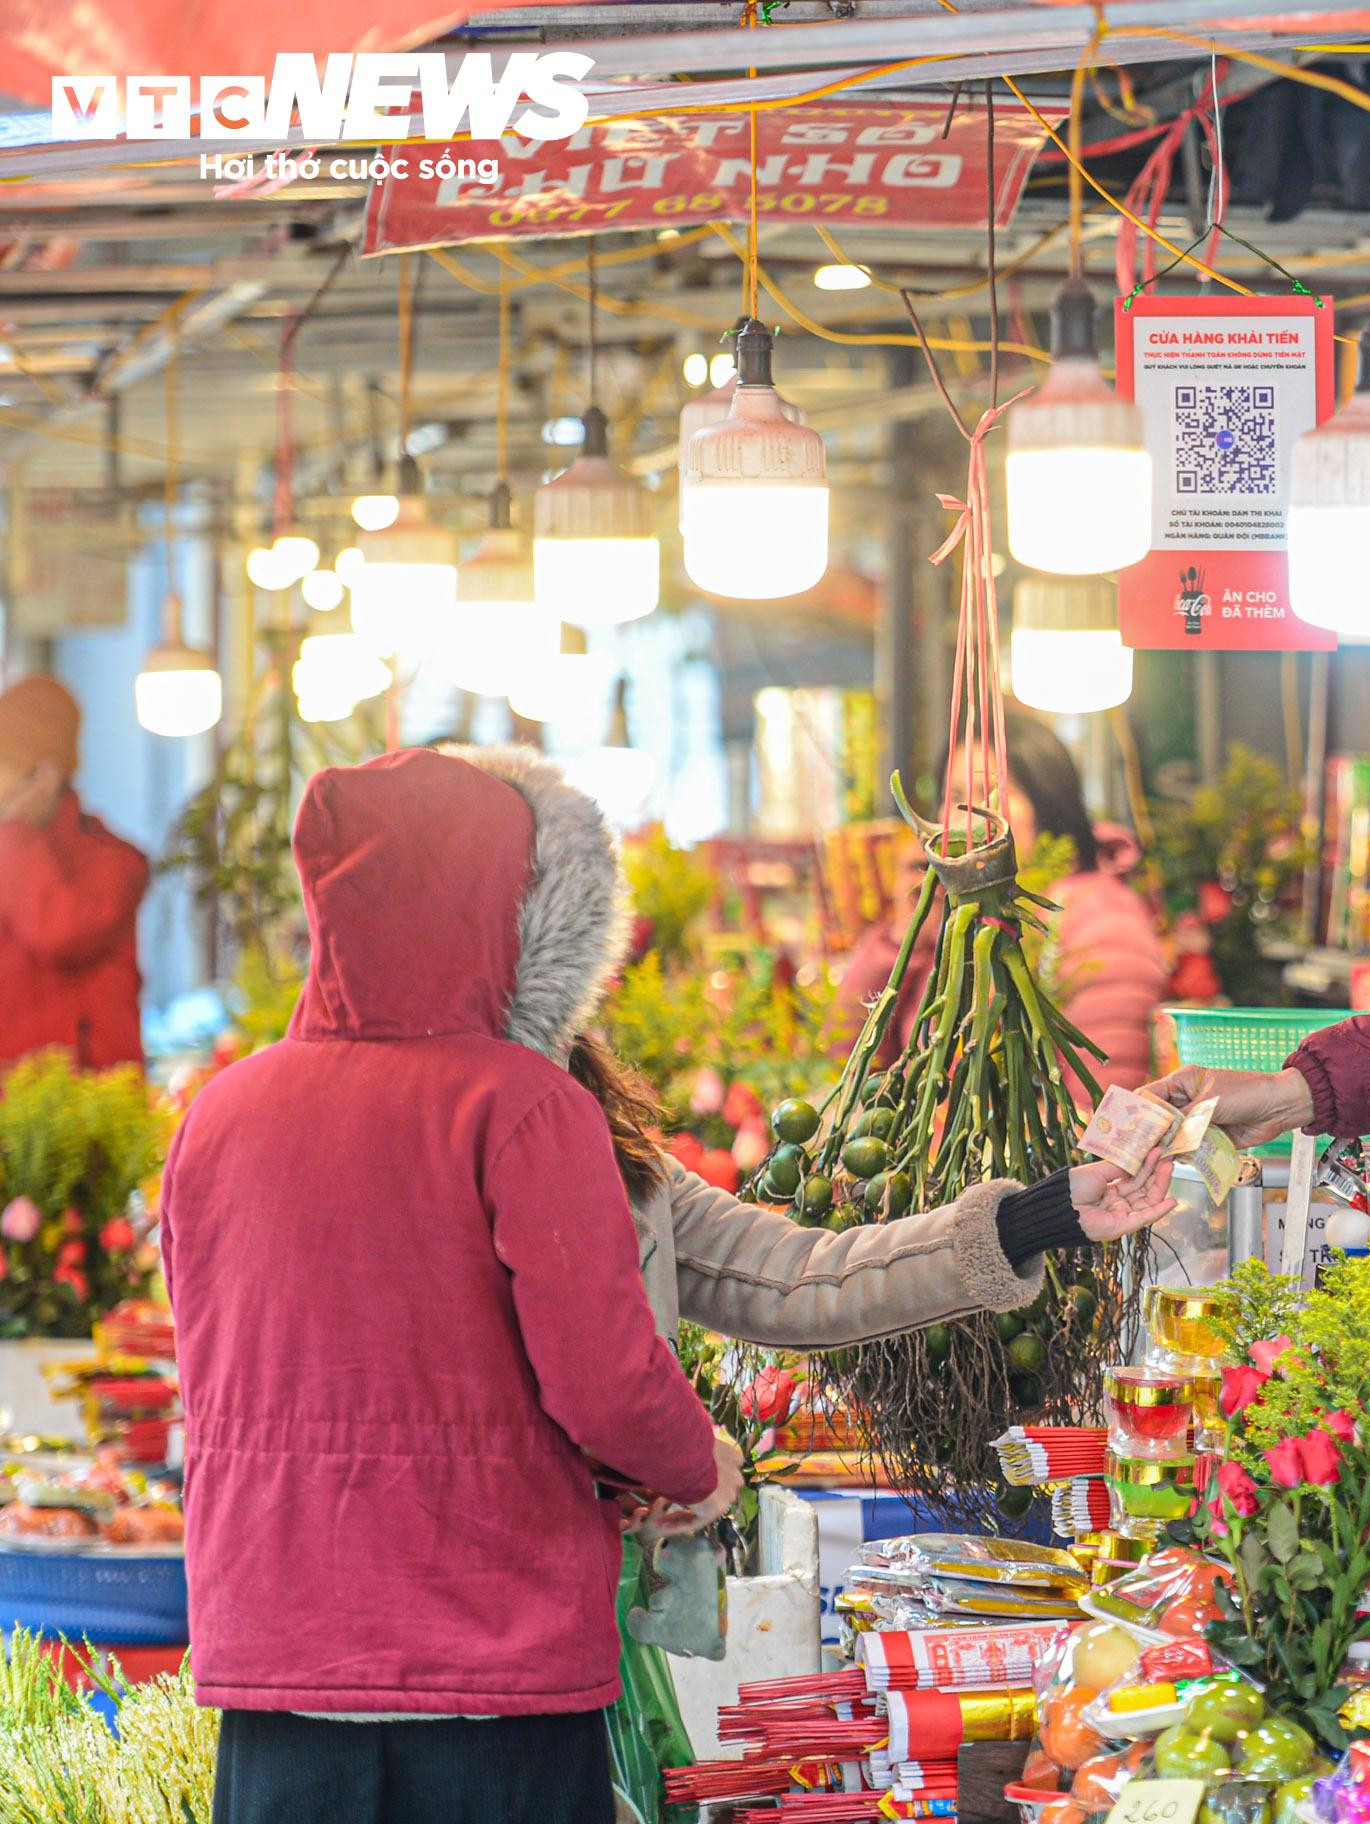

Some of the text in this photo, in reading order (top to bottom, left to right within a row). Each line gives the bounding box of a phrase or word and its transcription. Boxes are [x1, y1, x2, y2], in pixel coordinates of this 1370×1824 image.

[1149, 330, 1179, 344] CỬA
[1183, 331, 1224, 344] HÀNG
[1222, 589, 1277, 603] ĂN CHO
[1221, 604, 1242, 618] ĐÃ
